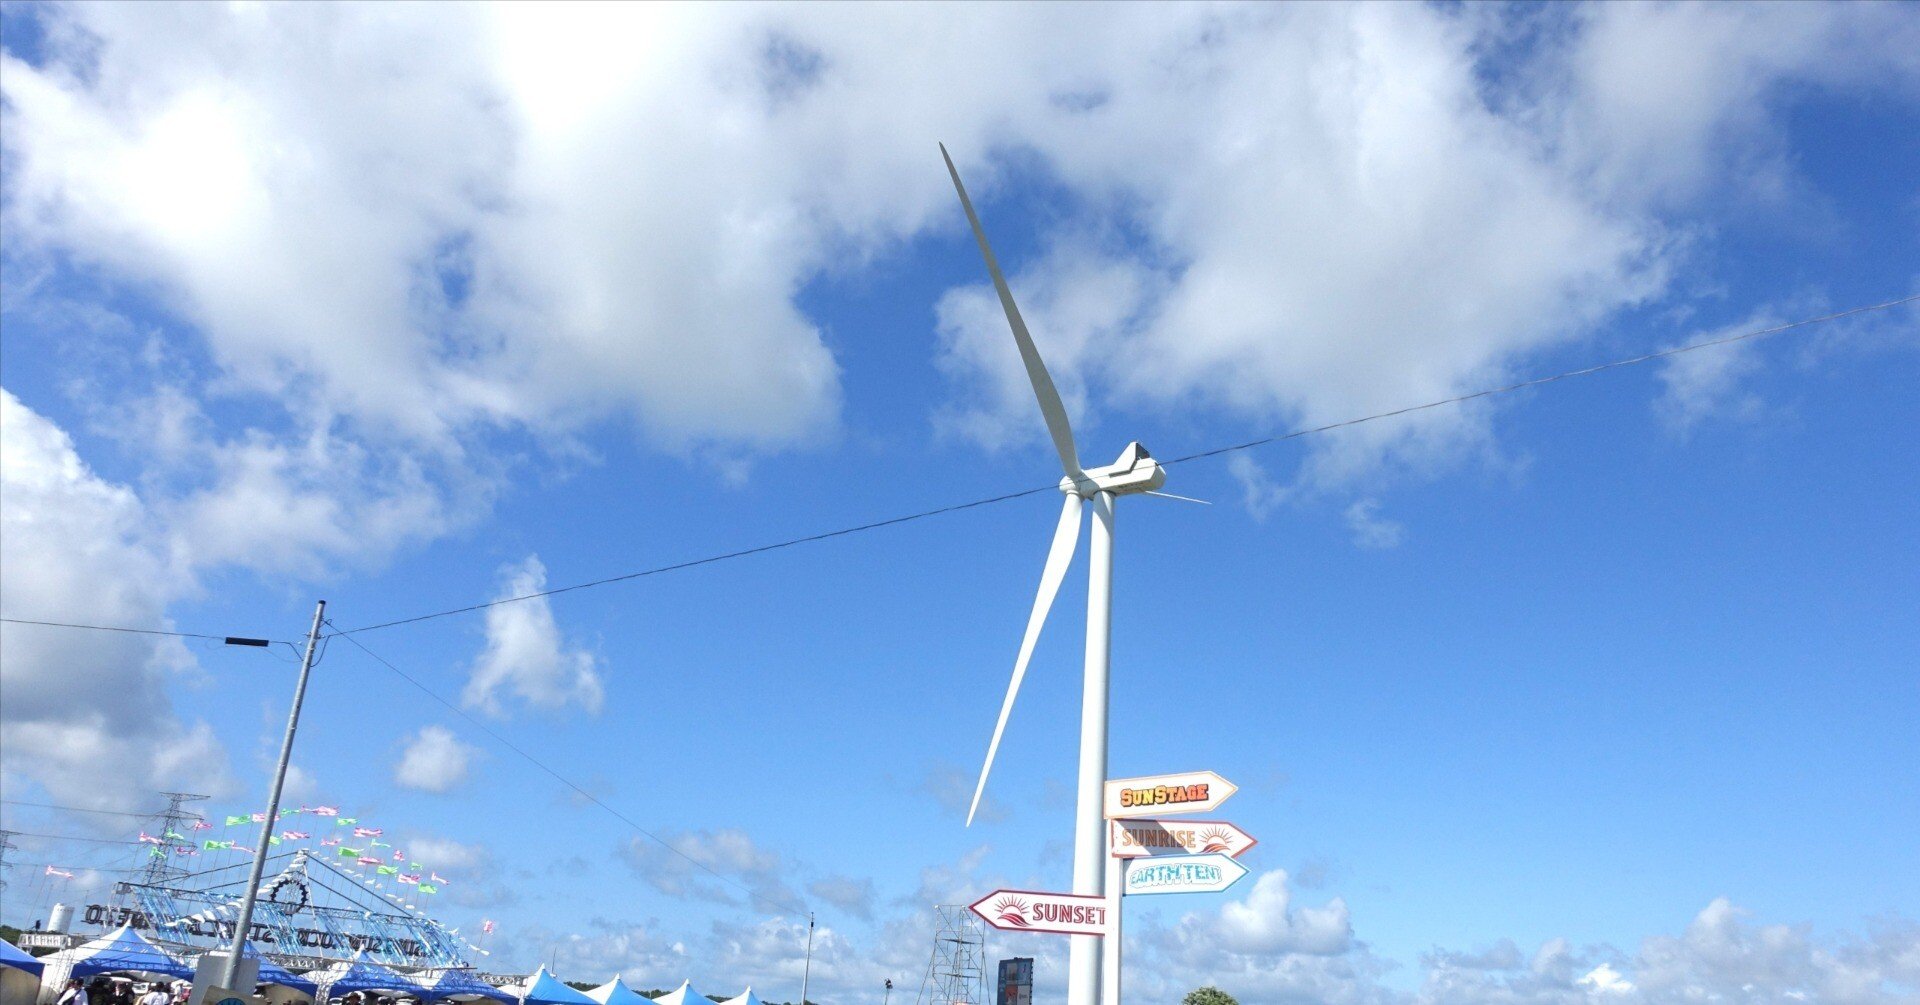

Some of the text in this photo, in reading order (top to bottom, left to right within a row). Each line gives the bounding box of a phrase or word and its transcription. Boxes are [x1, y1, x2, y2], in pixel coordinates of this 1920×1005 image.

[1122, 828, 1196, 848] SUNRISE
[1130, 862, 1222, 886] EARTH TENT
[1032, 902, 1106, 925] SUNSET
